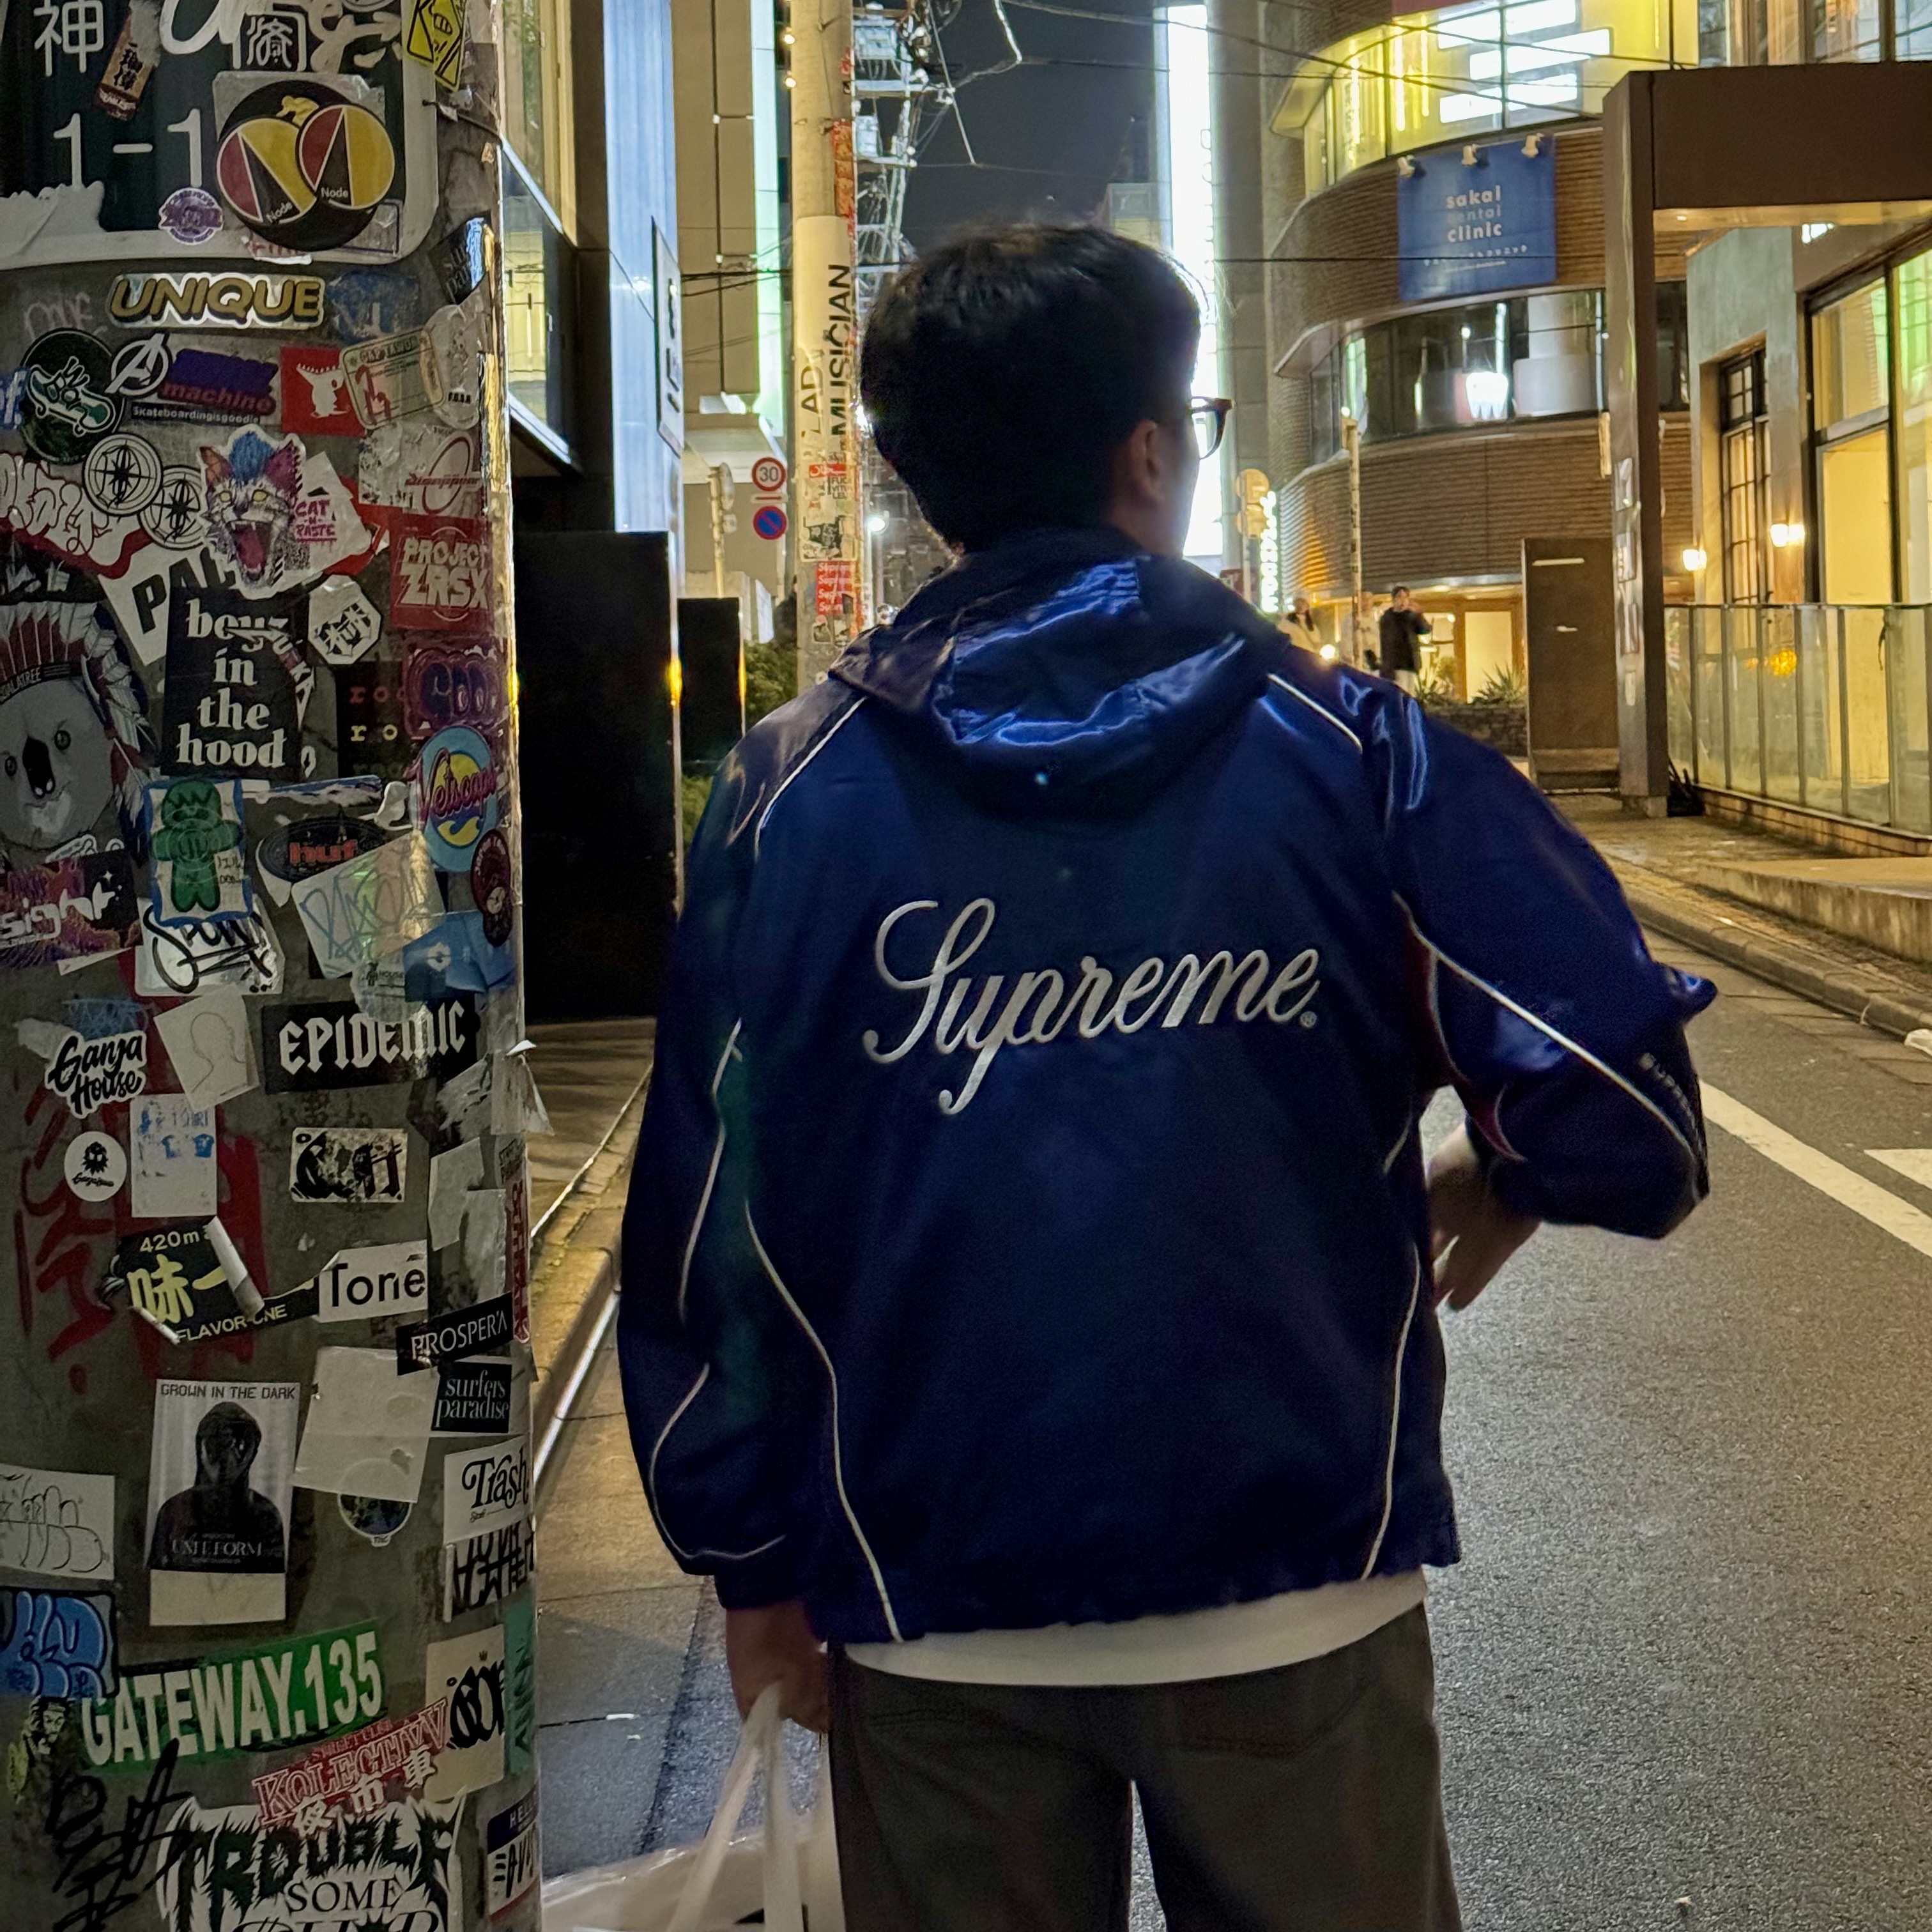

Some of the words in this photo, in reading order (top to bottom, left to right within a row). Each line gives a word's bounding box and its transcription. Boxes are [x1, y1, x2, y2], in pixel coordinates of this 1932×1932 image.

[321, 187, 349, 197] Node
[266, 202, 293, 223] Node
[1447, 221, 1502, 243] clinic
[111, 277, 321, 324] UNIQUE
[828, 264, 851, 436] MUSICIAN
[758, 466, 779, 483] 30
[295, 500, 330, 518] CAT
[296, 525, 335, 537] PASTE
[404, 537, 487, 568] PROJECT
[213, 647, 258, 686] in
[197, 687, 270, 730] the
[176, 723, 288, 768] hood
[289, 839, 358, 864] huf
[862, 898, 1321, 1116] Supreme
[279, 1000, 466, 1075] EPIDEMIC
[47, 1035, 143, 1092] Ganja
[70, 1070, 143, 1116] House
[161, 1383, 206, 1397] GROWN
[211, 1386, 225, 1399] IN
[231, 1386, 256, 1399] THE
[261, 1386, 296, 1400] DARK
[445, 1369, 506, 1399] surfers
[435, 1391, 510, 1429] paradise
[461, 1446, 530, 1510] Trash
[80, 1630, 383, 1767] GATEWAY.135
[288, 1878, 402, 1912] SOME
